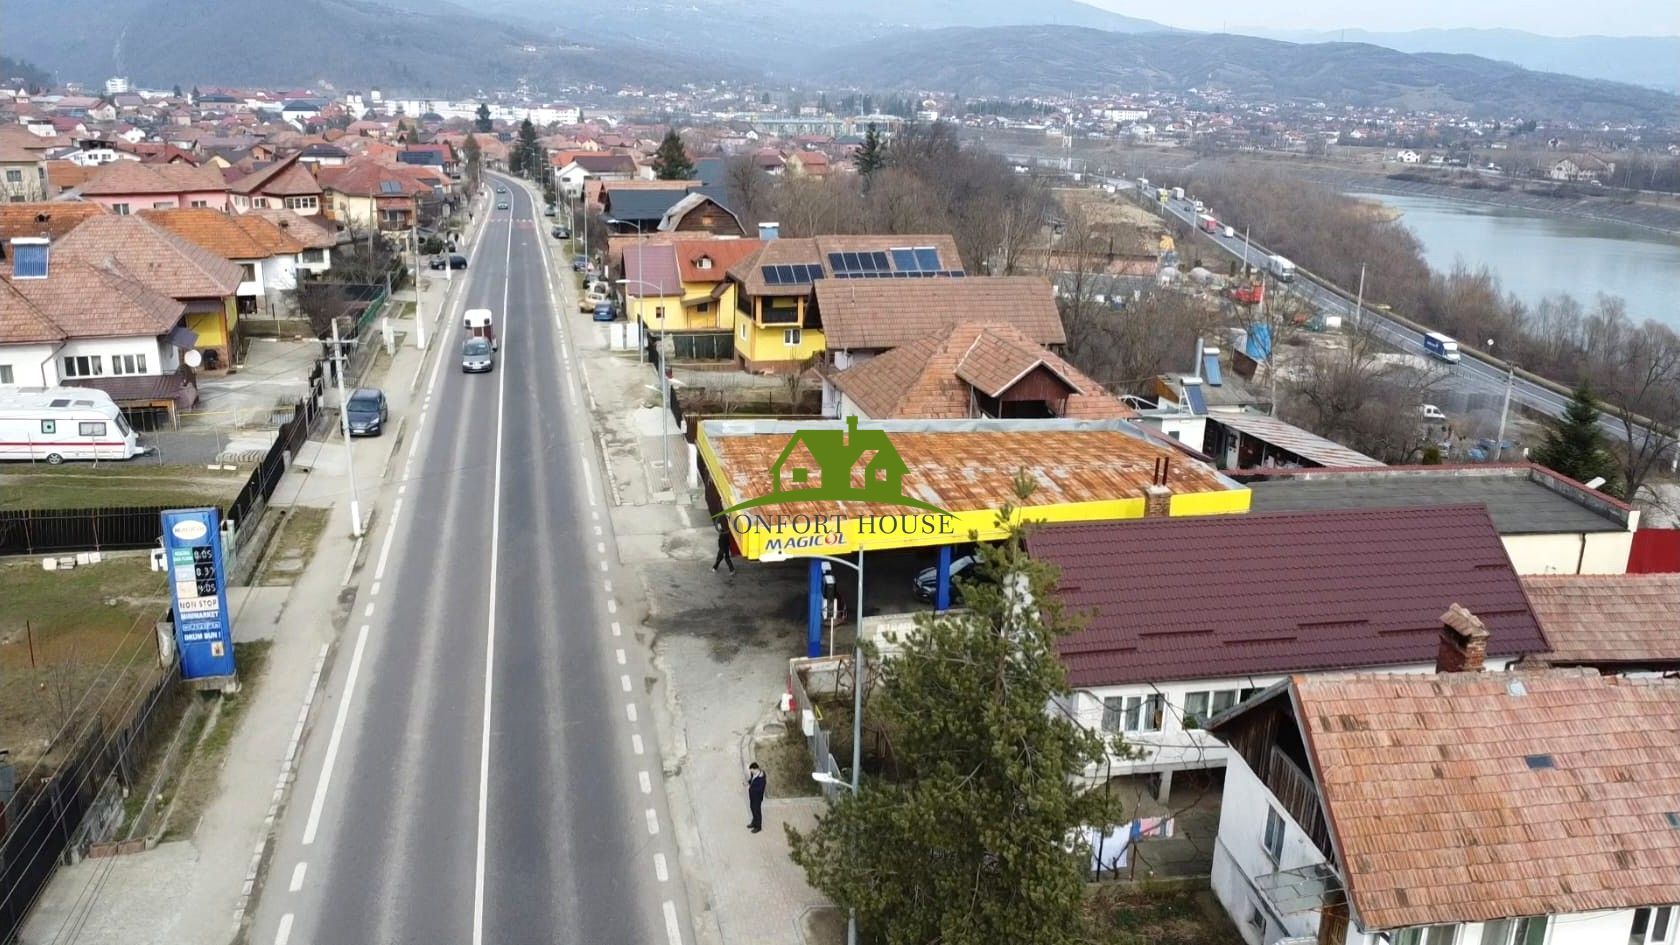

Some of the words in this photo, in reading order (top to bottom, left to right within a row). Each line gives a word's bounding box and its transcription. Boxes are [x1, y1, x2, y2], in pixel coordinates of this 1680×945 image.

[765, 531, 847, 550] MAGICOL
[180, 601, 197, 609] NON
[199, 599, 217, 608] STOP
